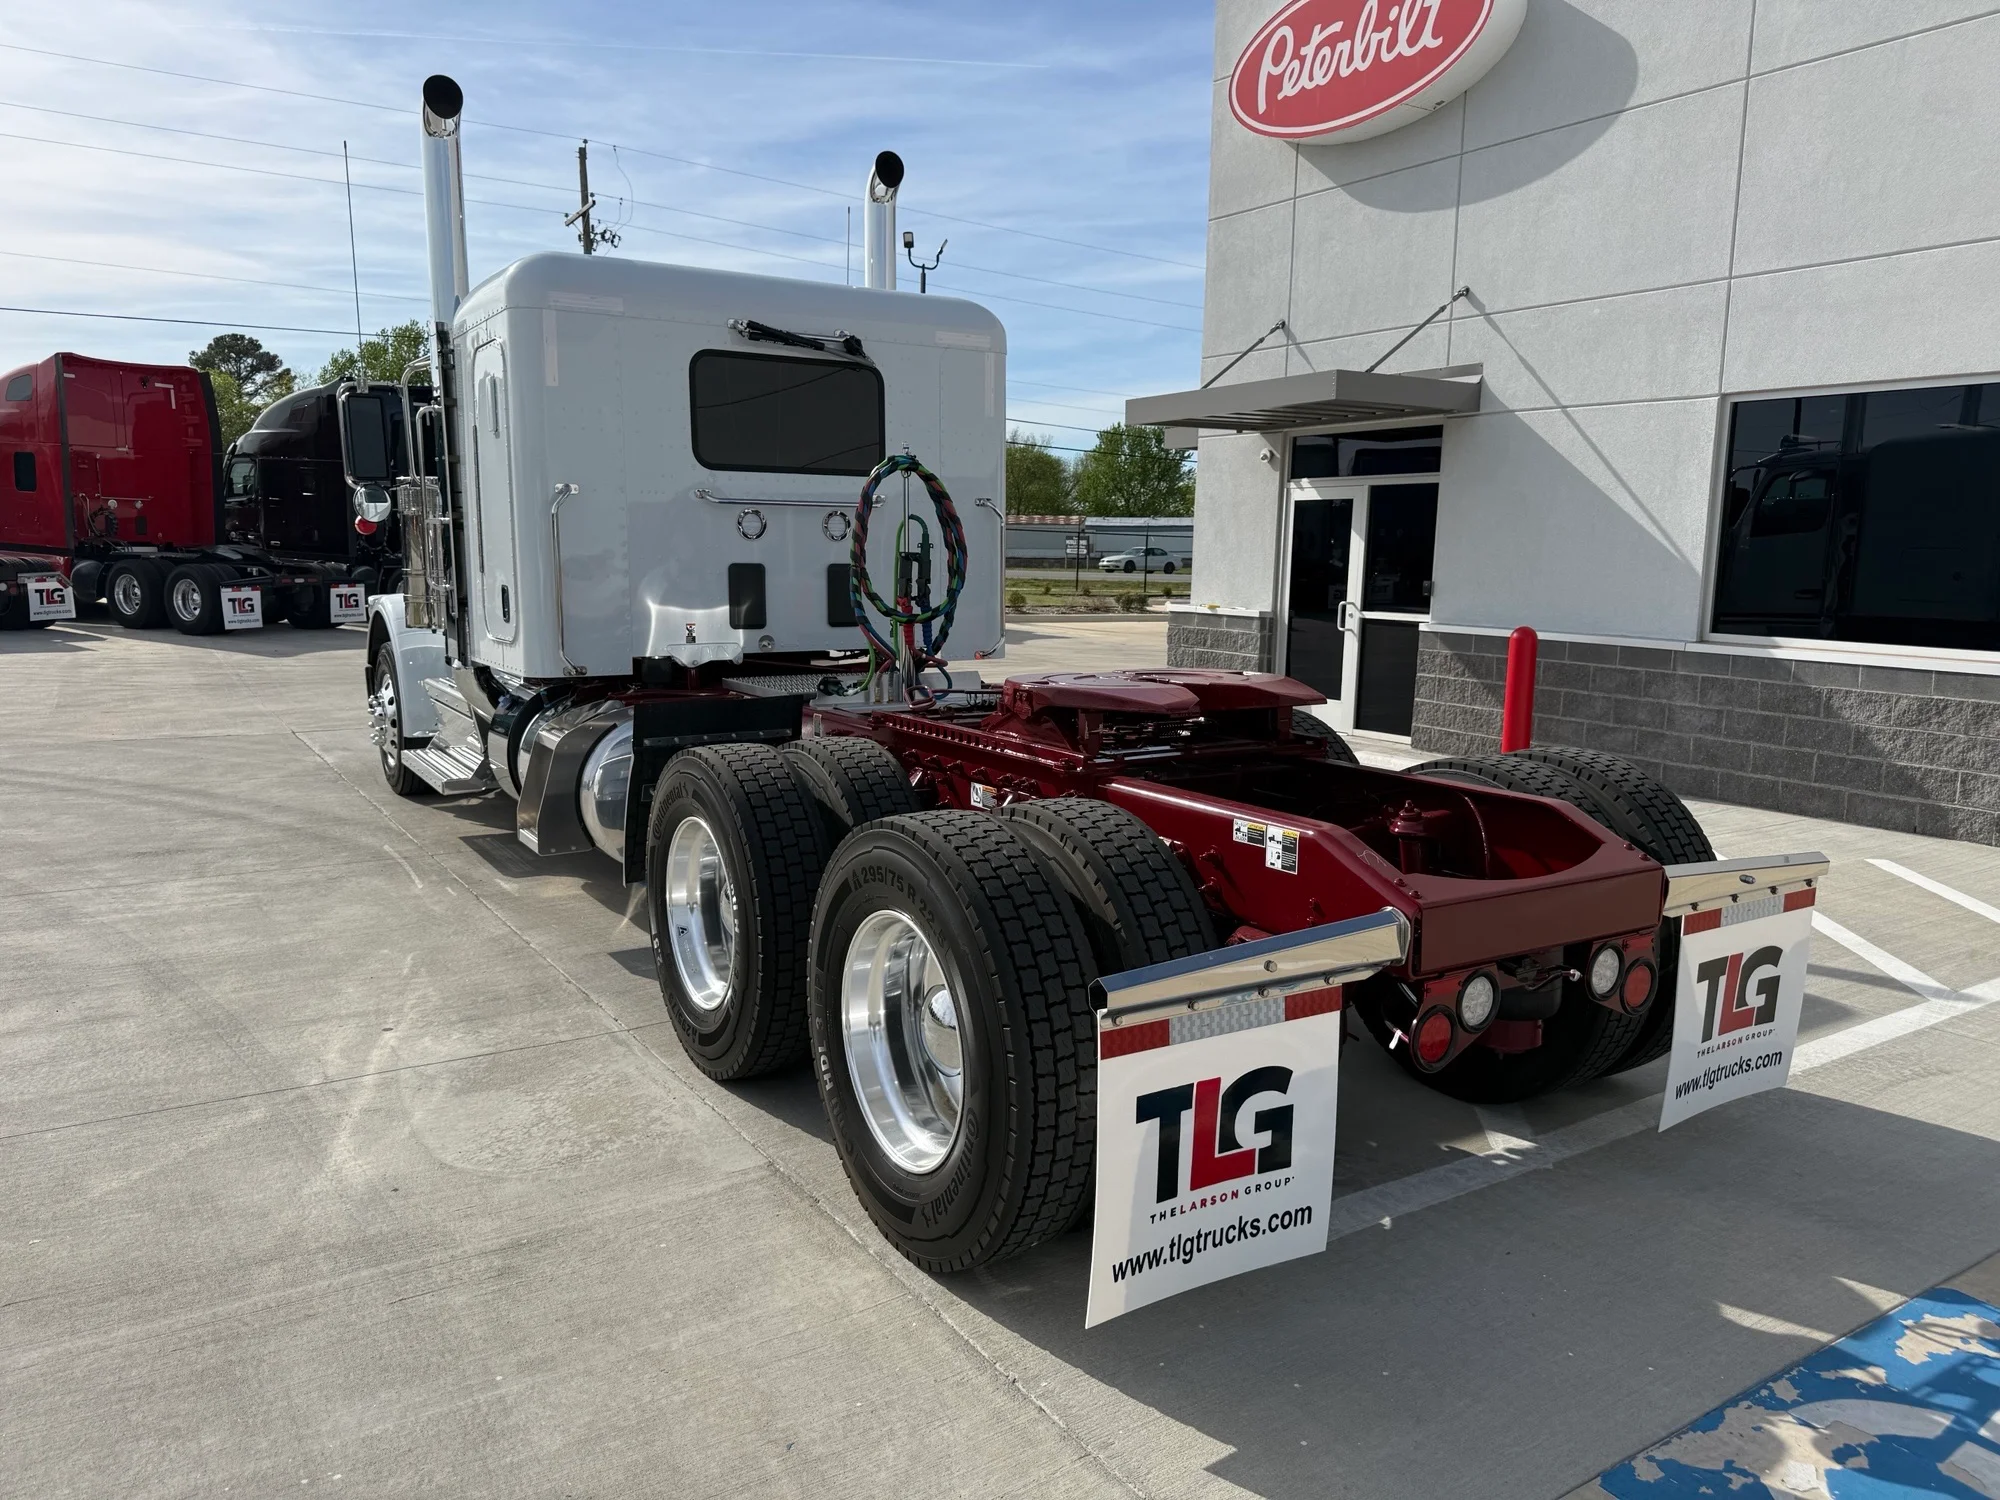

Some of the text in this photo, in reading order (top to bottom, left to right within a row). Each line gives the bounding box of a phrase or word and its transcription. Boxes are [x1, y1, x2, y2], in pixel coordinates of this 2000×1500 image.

[1257, 0, 1443, 114] Peterbilt
[34, 588, 66, 606] TLG
[227, 597, 255, 615] TLG
[336, 593, 360, 609] TLG
[653, 781, 684, 840] Continental
[861, 864, 905, 894] 295/75
[907, 883, 916, 904] R
[1696, 945, 1784, 1044] TLG
[1745, 1029, 1773, 1041] GROUP
[818, 1040, 834, 1091] HDL
[1675, 1051, 1783, 1100] www.tlgtrucks.com
[1135, 1065, 1295, 1204] TLG
[930, 1107, 979, 1225] Continental
[1244, 1177, 1291, 1195] GROUP
[1112, 1205, 1313, 1284] www.tlgtrucks.com
